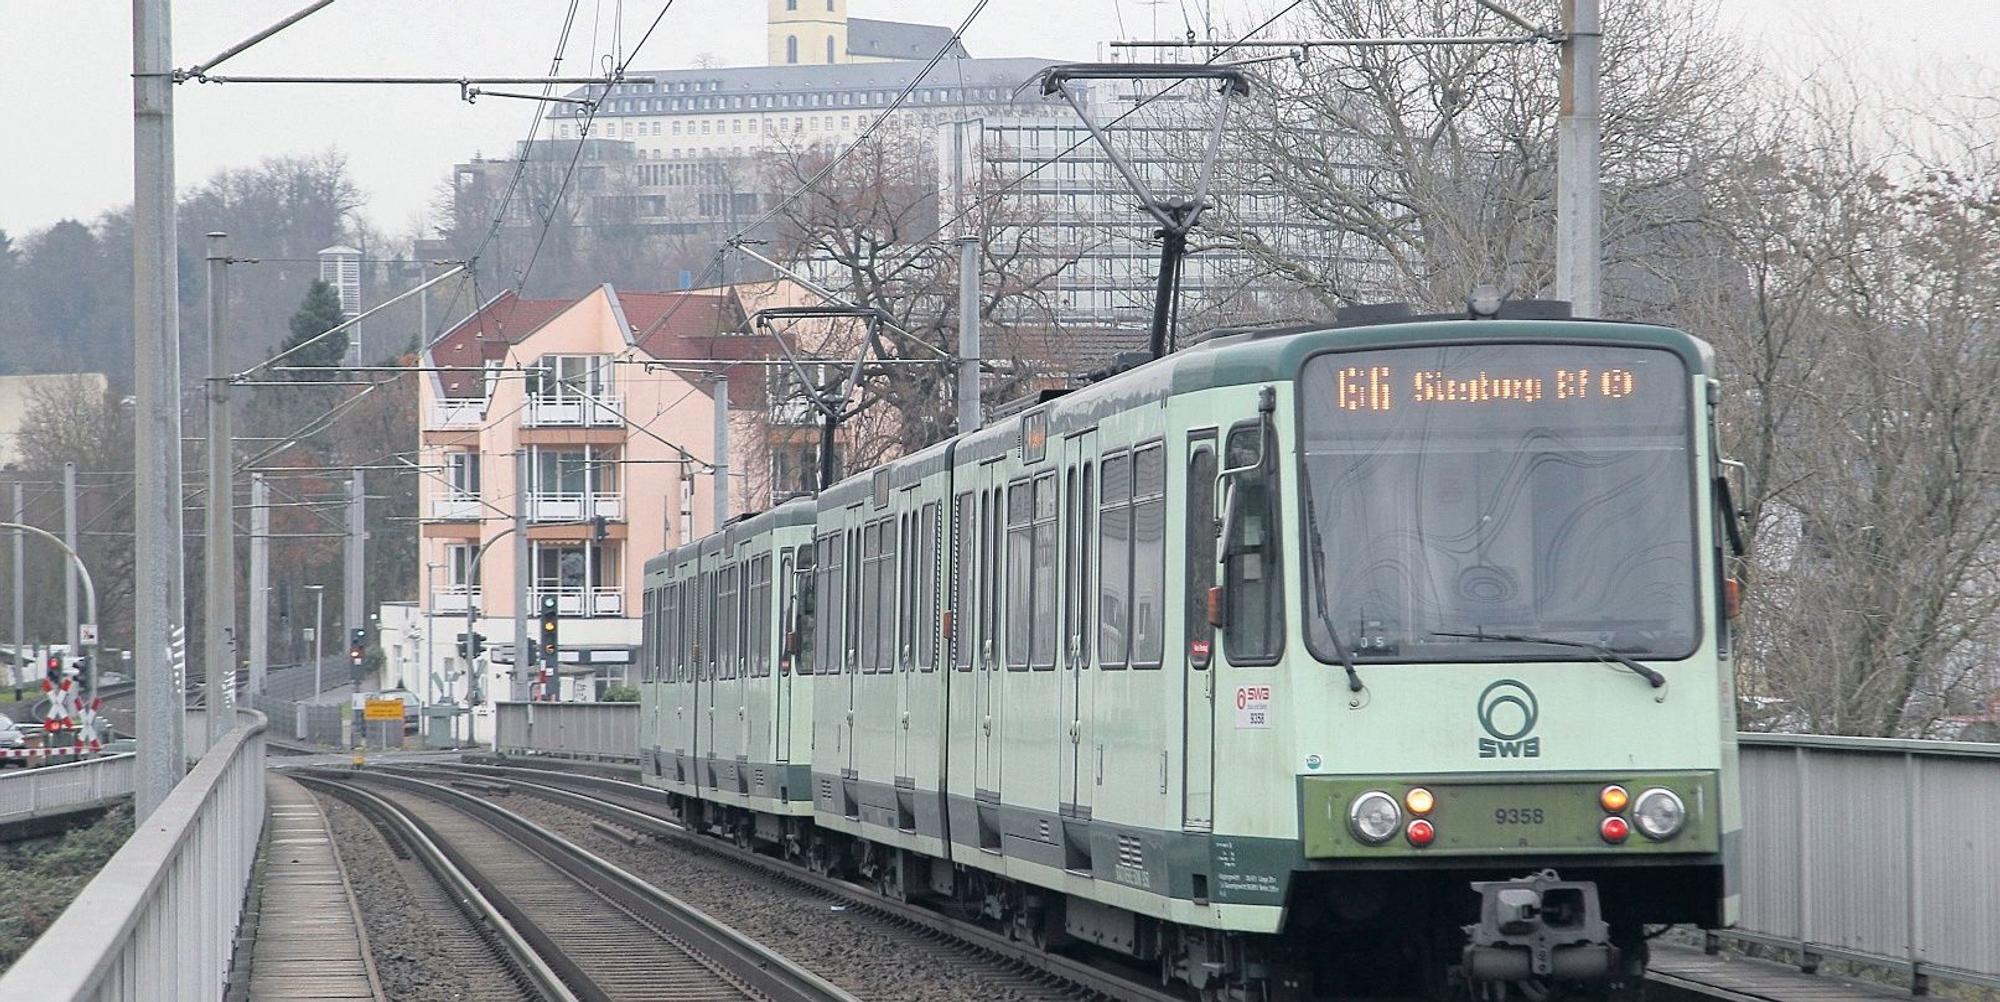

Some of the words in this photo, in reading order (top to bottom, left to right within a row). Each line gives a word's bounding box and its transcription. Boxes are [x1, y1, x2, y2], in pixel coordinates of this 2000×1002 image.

[1247, 687, 1270, 701] SWB
[1478, 736, 1540, 759] SWB
[1494, 808, 1544, 825] 9358
